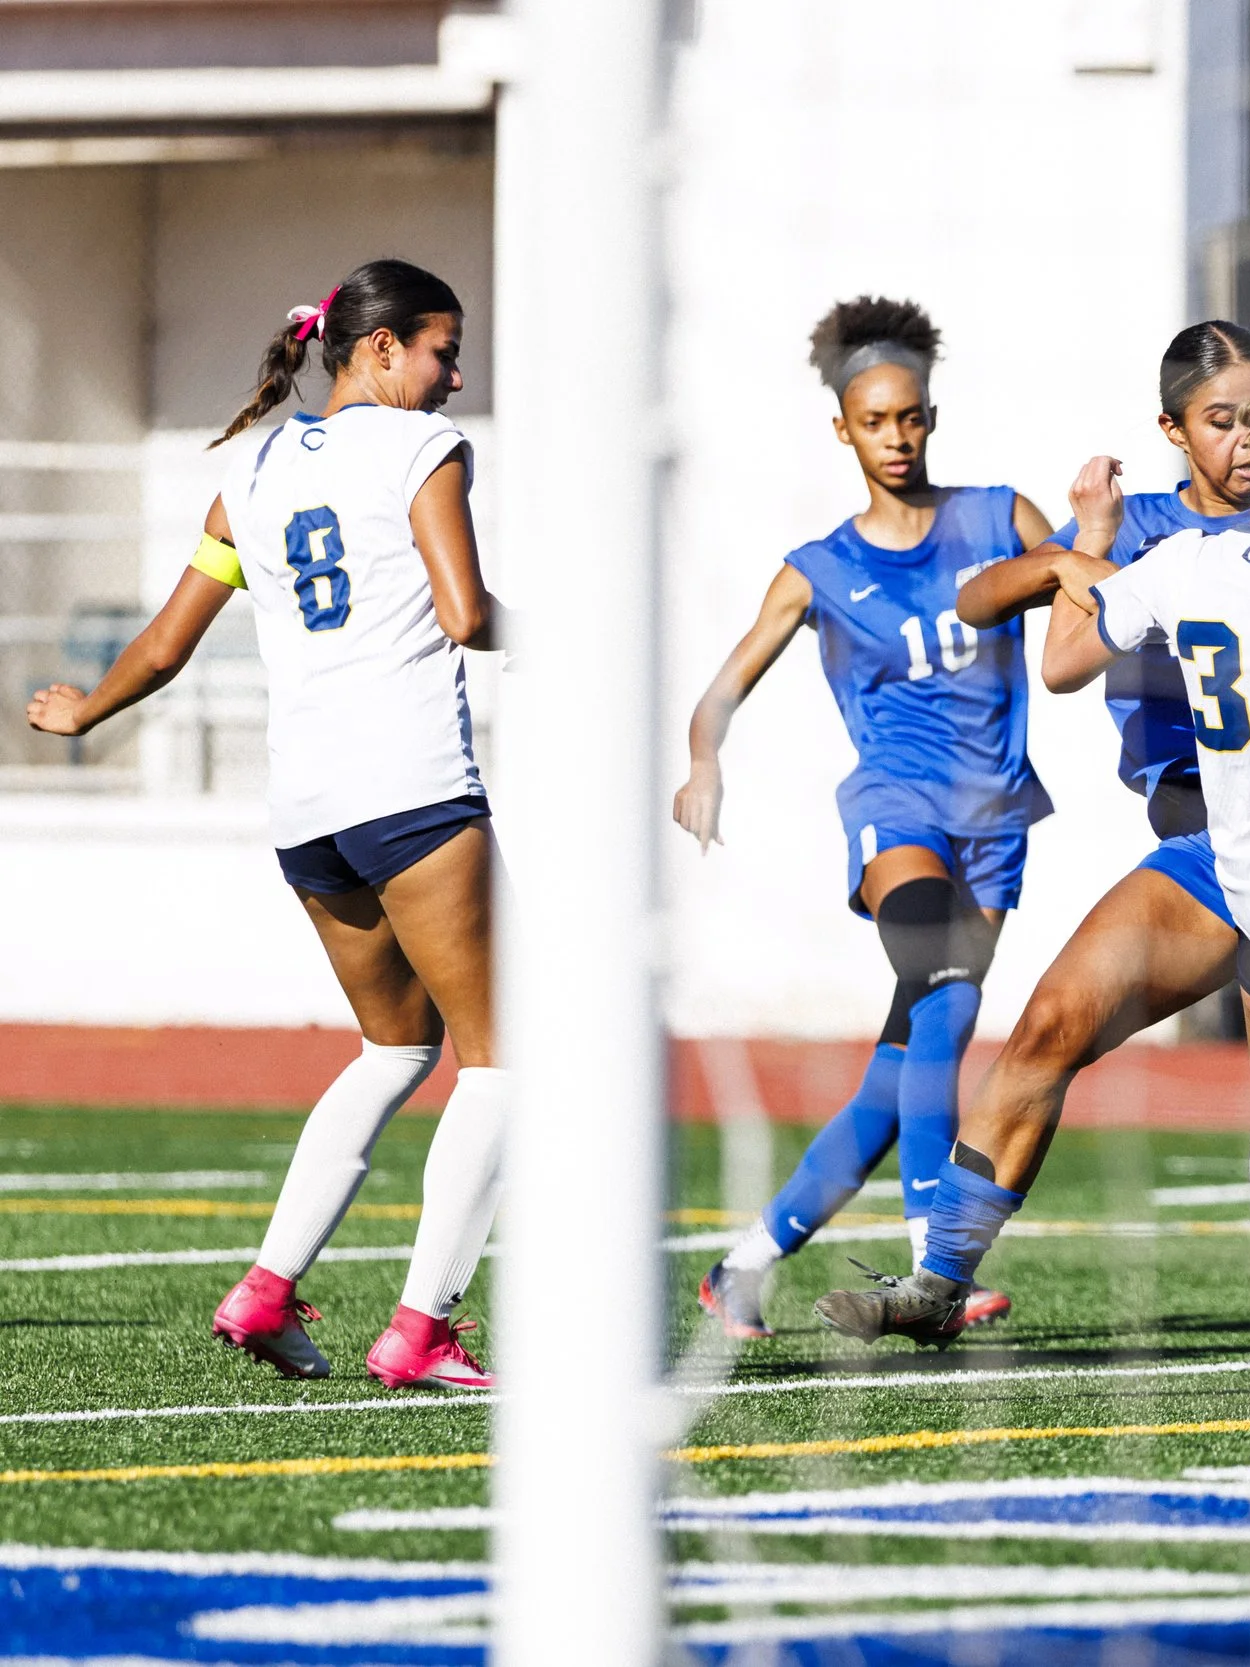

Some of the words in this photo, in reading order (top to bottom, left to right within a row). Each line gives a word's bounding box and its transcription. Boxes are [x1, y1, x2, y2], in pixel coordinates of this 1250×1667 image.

[300, 428, 327, 451] C
[284, 504, 352, 634] 8
[900, 608, 978, 682] 10
